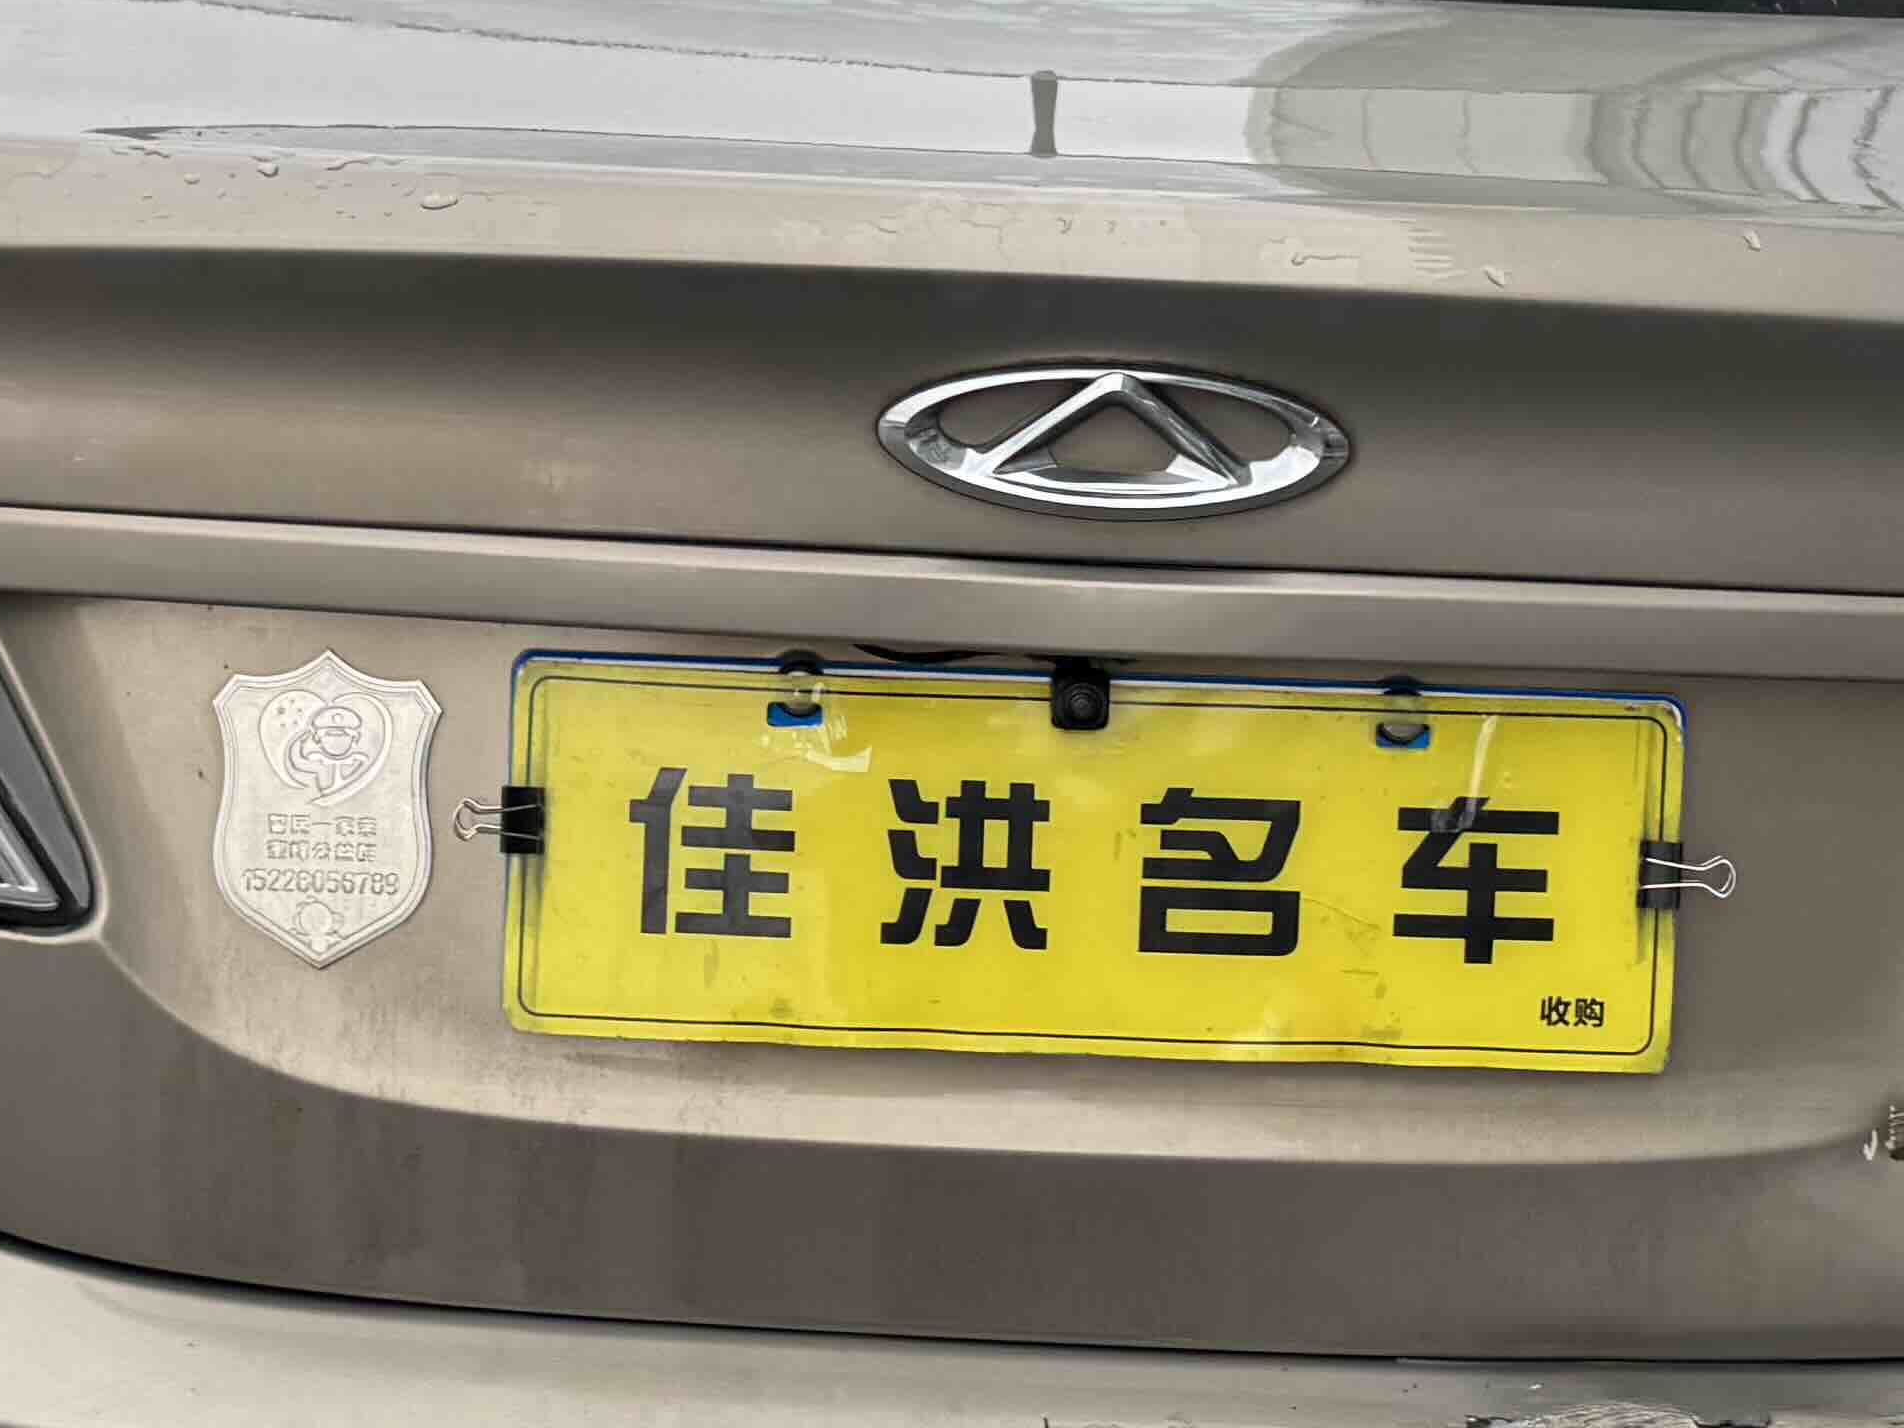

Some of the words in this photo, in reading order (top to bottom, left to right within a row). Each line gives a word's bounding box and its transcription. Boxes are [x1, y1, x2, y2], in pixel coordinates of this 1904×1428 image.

[629, 766, 1561, 964] 佳洪名车
[1539, 996, 1606, 1030] 收购
